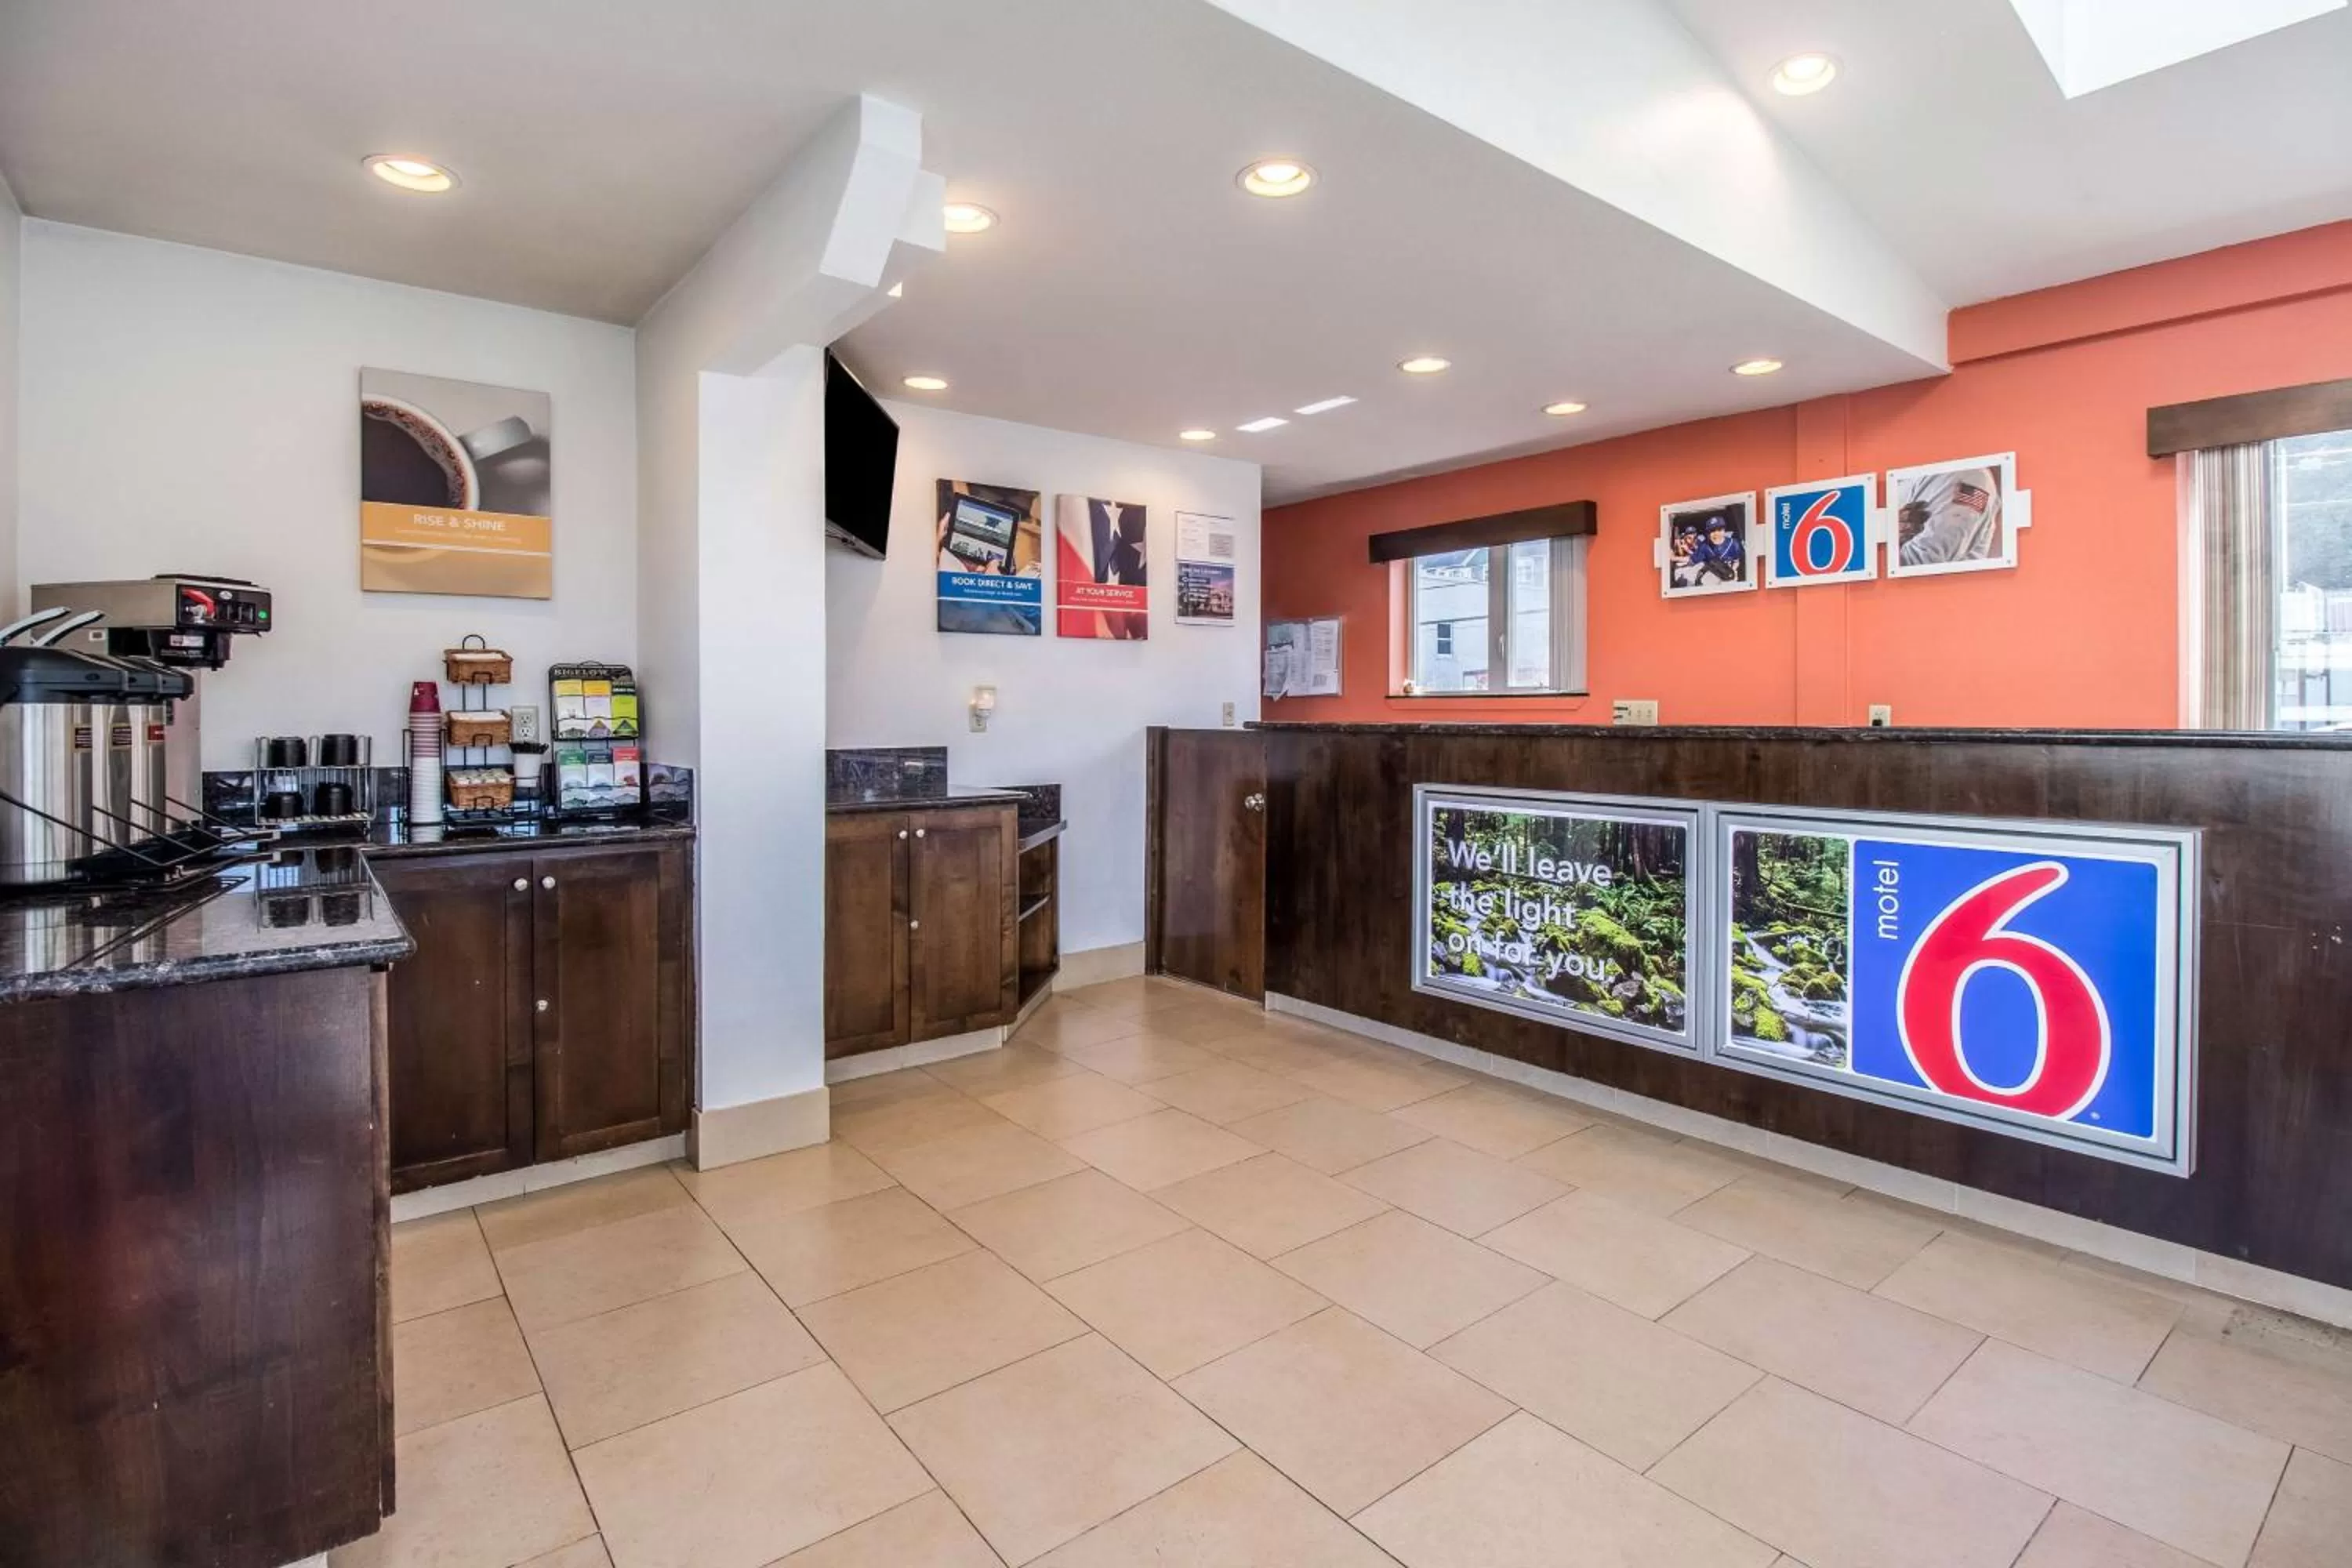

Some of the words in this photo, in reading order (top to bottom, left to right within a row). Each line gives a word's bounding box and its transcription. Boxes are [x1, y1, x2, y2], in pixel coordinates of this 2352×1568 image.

[413, 514, 445, 526] RISE
[449, 515, 459, 528] &
[463, 517, 506, 531] SHINE
[1780, 502, 1791, 529] motel
[1790, 490, 1853, 576] 6
[951, 576, 976, 586] BOOK
[978, 578, 1004, 589] DIRECT
[1014, 582, 1033, 590] SAVE
[1086, 587, 1105, 597] YOUR
[1106, 589, 1134, 598] SERVICE
[1448, 839, 1517, 874] We'll
[1529, 847, 1613, 886] leave
[1450, 881, 1494, 916] the
[1504, 888, 1577, 931] light
[1449, 932, 1482, 956] on
[1493, 930, 1537, 966] for
[1872, 860, 1899, 940] motel
[1896, 860, 2111, 1122] 6
